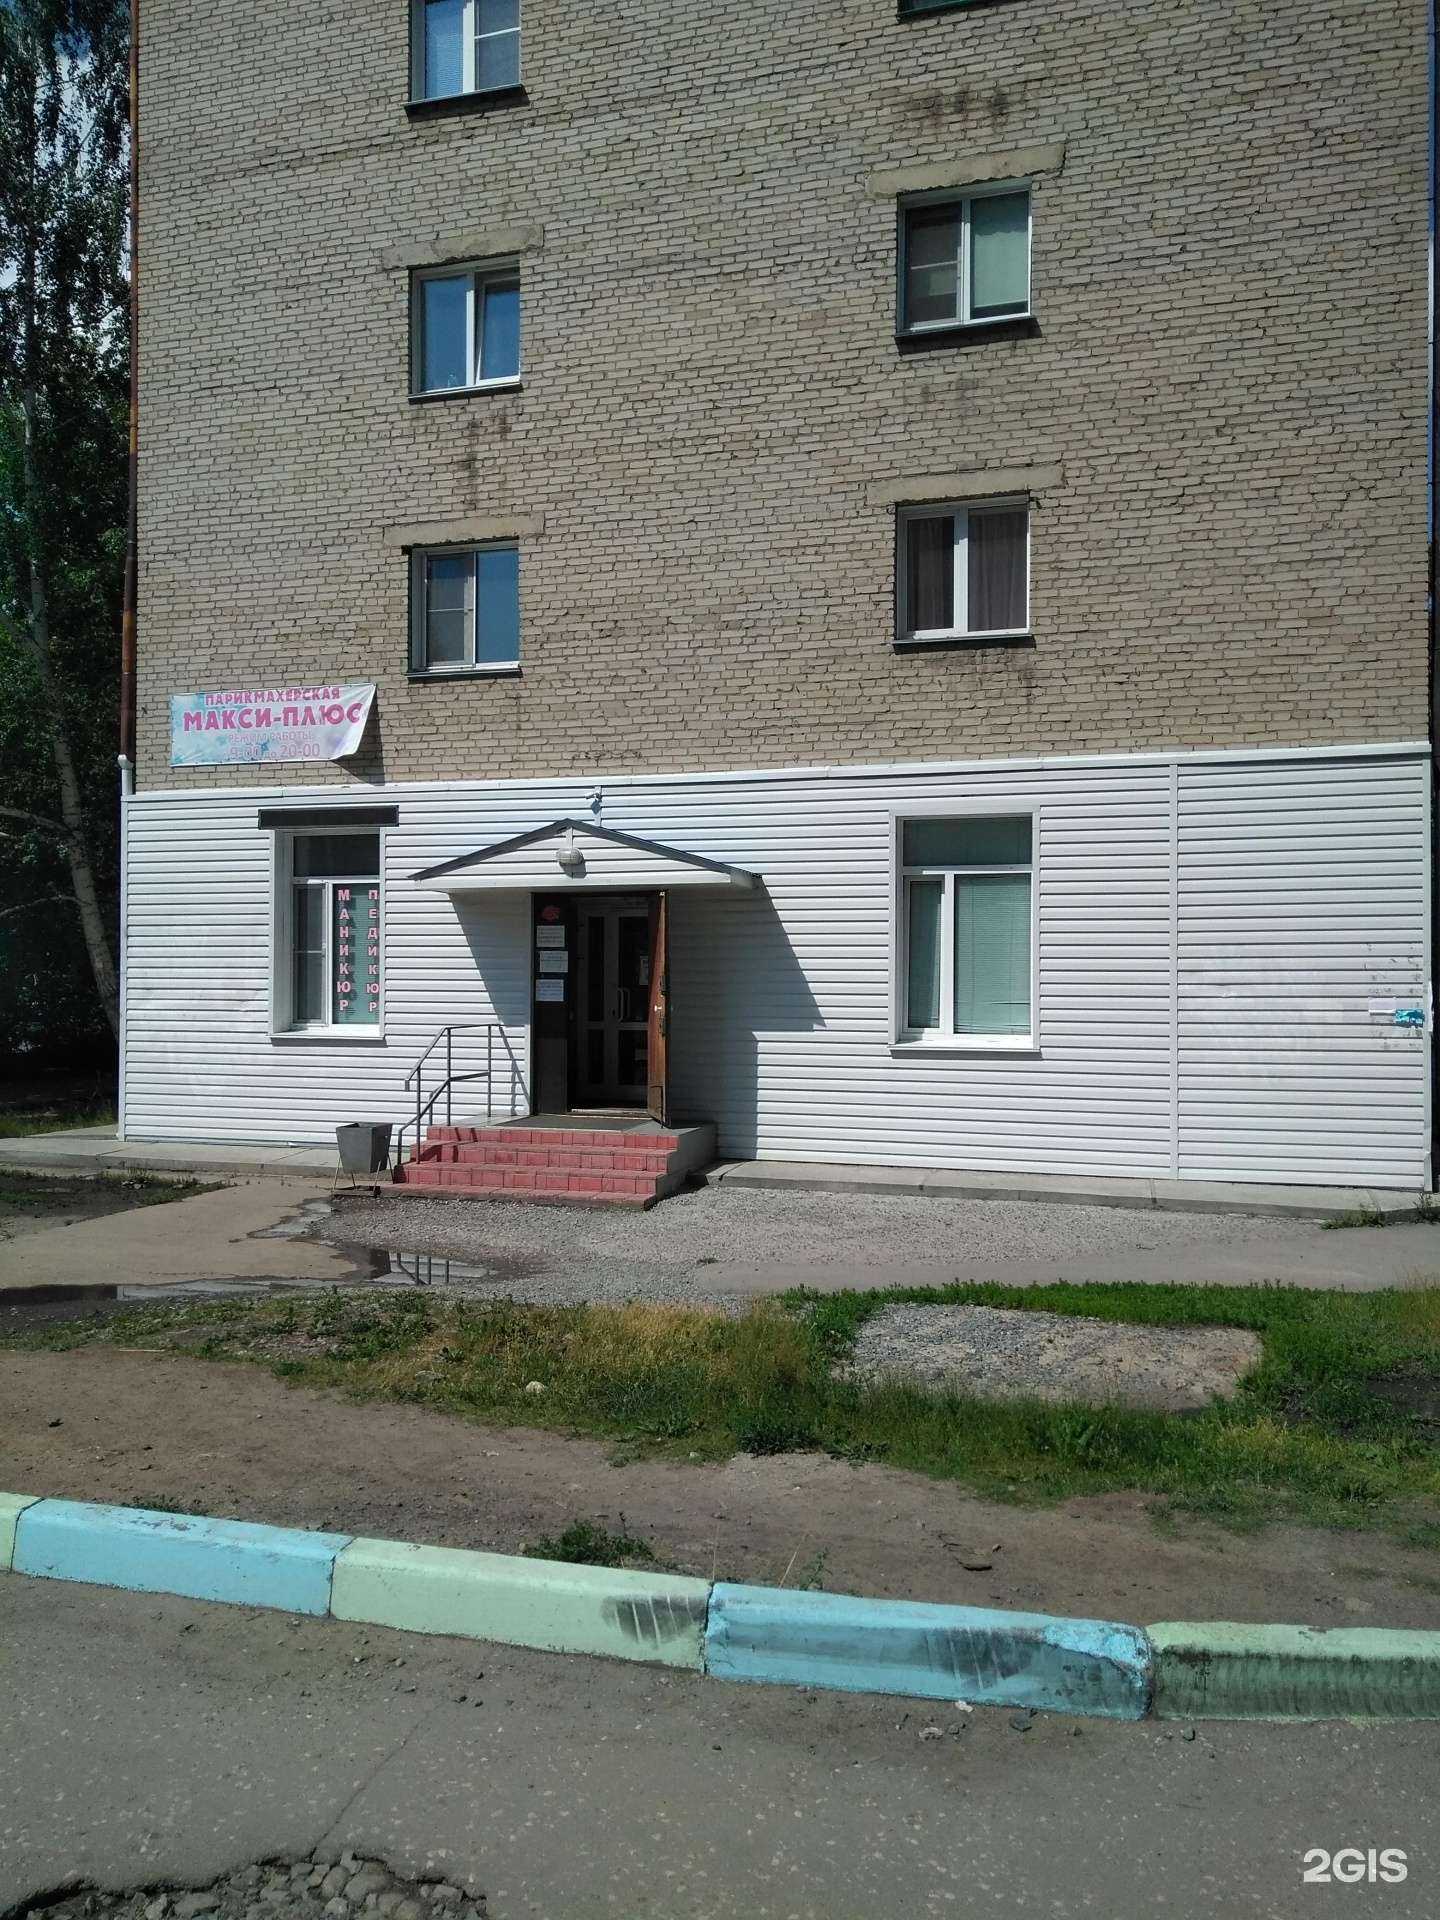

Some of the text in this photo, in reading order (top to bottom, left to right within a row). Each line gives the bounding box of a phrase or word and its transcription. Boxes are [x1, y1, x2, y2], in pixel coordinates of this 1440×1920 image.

[205, 687, 341, 706] ПАРИКМАХЕРСКАЯ
[183, 702, 364, 732] МАКСИ-ПЛЮС
[228, 733, 267, 745] РЕЖИМ
[280, 743, 320, 758] 20-00
[336, 889, 351, 1012] МАНИКЮР
[366, 889, 379, 1012] ПЕДИКЮР
